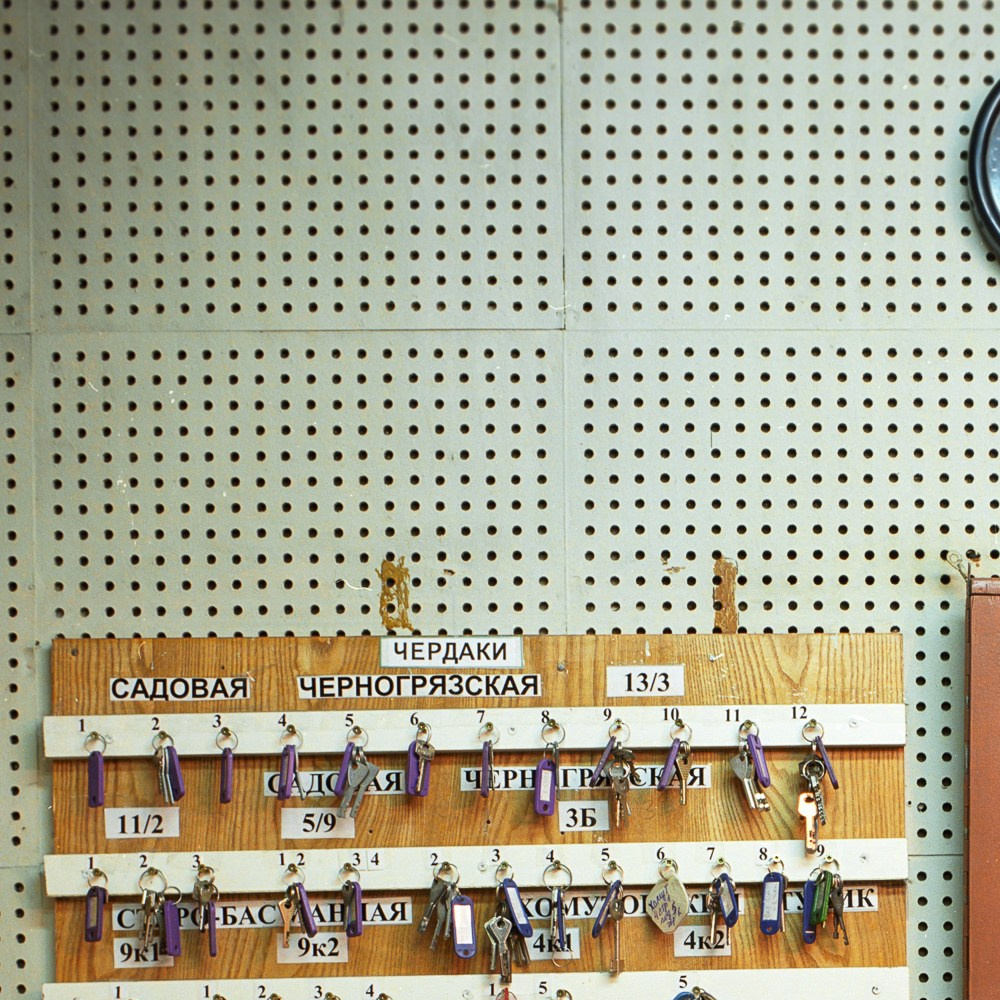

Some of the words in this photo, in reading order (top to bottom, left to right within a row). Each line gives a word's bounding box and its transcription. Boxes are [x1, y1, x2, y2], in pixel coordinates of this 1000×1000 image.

[394, 643, 507, 664] ЧЕРДАКИ
[111, 677, 249, 700] САДОВАЯ
[299, 674, 539, 695] ЧЕРНОГРЯЗСКАЯ
[624, 672, 670, 694] 13/3
[79, 719, 86, 733] 1
[151, 718, 160, 731] 2
[212, 715, 222, 728] 3
[278, 714, 287, 727] 4
[345, 713, 353, 727] 5
[410, 712, 419, 726] 6
[477, 711, 486, 724] 7
[541, 710, 549, 724] 8
[603, 708, 612, 722] 9
[663, 708, 679, 721] 10
[725, 708, 740, 722] 11
[791, 706, 808, 719] 12
[268, 772, 402, 796] САДОАЯ
[464, 767, 705, 788] ЧЕРНГРЯСКАЯ
[118, 813, 164, 835] 11/2
[302, 813, 337, 834] 5/9
[566, 808, 597, 828] 3Б
[88, 856, 94, 870] 1
[139, 855, 148, 868] 2
[192, 854, 201, 868] 3
[279, 853, 285, 866] 1
[296, 853, 305, 866] 2
[352, 853, 361, 867] 3
[370, 852, 379, 866] 4
[430, 853, 439, 867] 2
[492, 849, 500, 862] 3
[546, 849, 555, 862] 4
[601, 847, 609, 861] 5
[656, 846, 665, 860] 6
[707, 846, 715, 859] 7
[759, 846, 768, 860] 8
[816, 844, 825, 858] 9
[298, 938, 339, 957] 9к2
[684, 931, 725, 949] 4к2
[120, 943, 158, 962] 9к1
[115, 986, 121, 999] 1
[204, 985, 210, 998] 1
[258, 985, 267, 999] 2
[314, 985, 323, 999] 3
[366, 984, 375, 998] 4
[489, 983, 495, 997] 1
[539, 981, 547, 995] 5
[679, 975, 687, 989] 5
